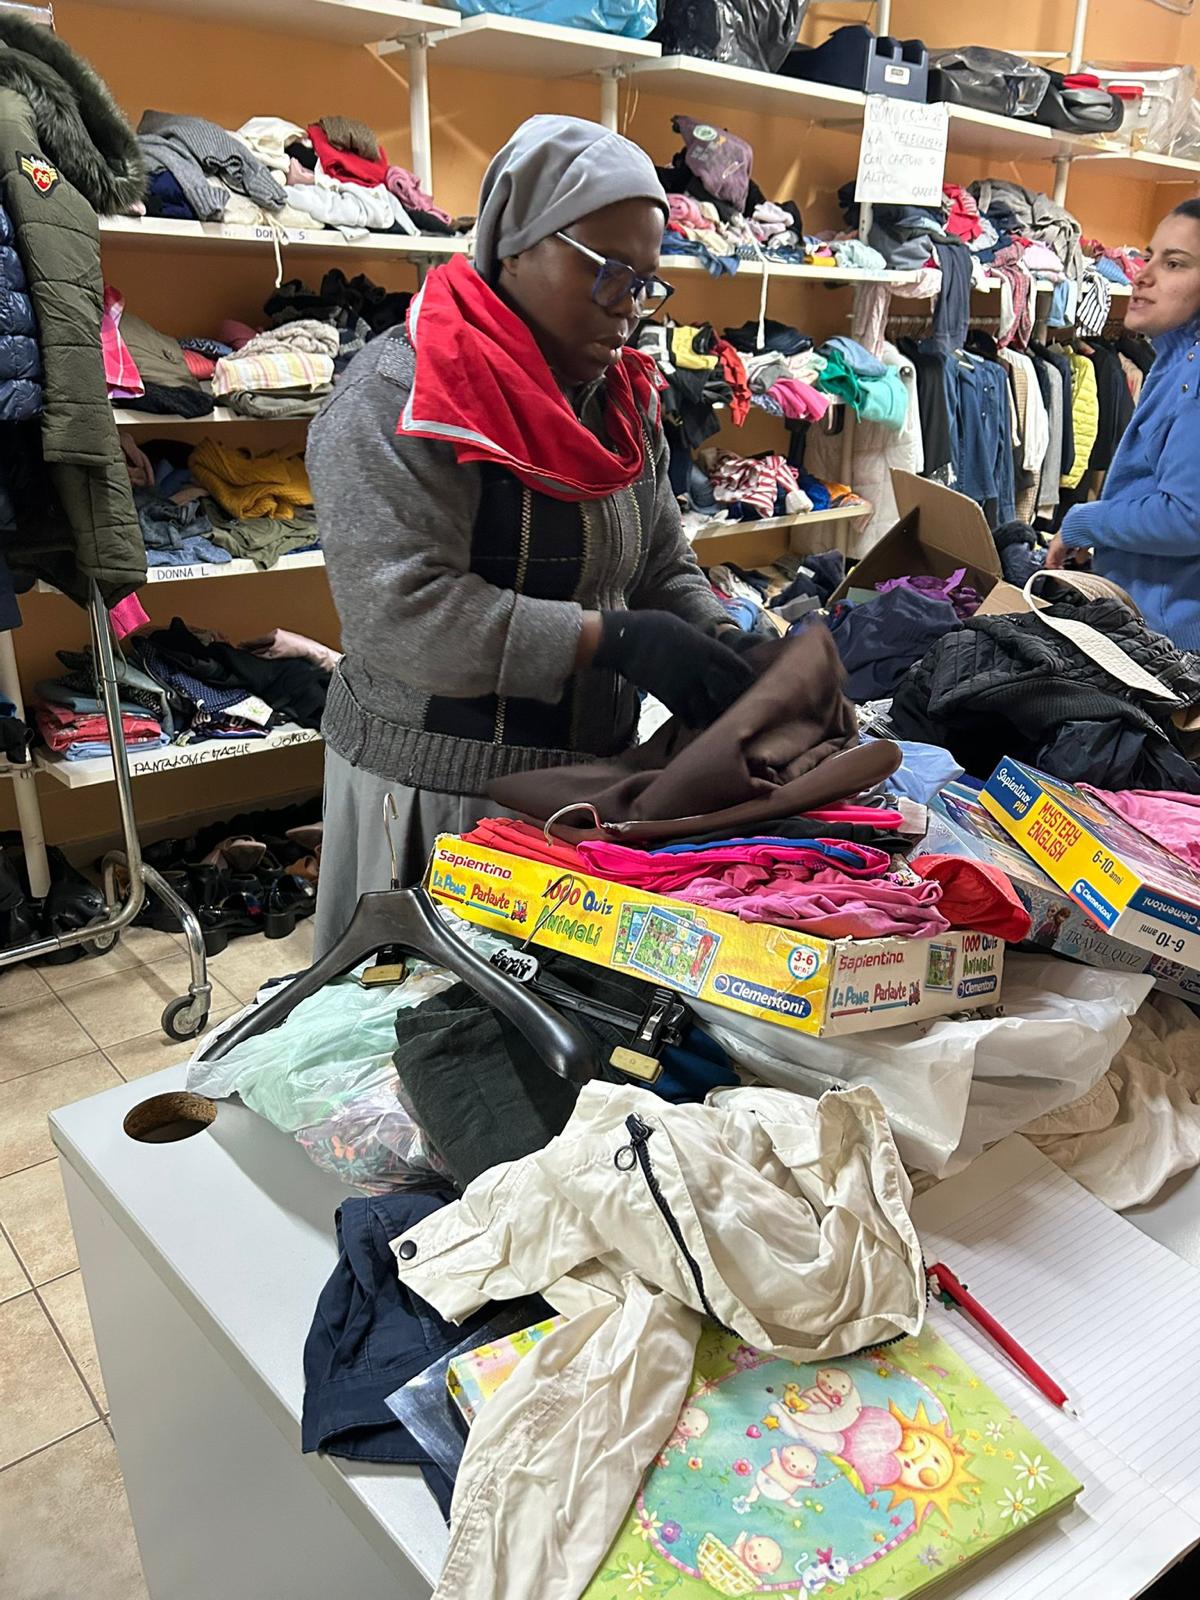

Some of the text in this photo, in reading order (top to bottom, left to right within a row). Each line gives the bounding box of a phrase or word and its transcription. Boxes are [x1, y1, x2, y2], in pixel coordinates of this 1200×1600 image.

[299, 231, 306, 240] S
[157, 566, 209, 580] DONNA L
[997, 768, 1032, 803] Sapientino
[1038, 801, 1083, 847] MYSTERY
[1027, 820, 1068, 862] ENGLISH
[433, 870, 442, 888] La
[438, 849, 512, 880] Sapientino
[1092, 850, 1124, 885] 6-10 anni
[546, 879, 614, 916] 1000 Quiz
[1082, 888, 1114, 921] Clementoni
[1142, 897, 1198, 925] Clementoni
[961, 934, 981, 954] 1000
[1066, 931, 1142, 967] TRAVEL QUIZ
[1140, 923, 1185, 952] 6-10 anni
[793, 951, 813, 966] 3-6
[838, 951, 904, 973] Sapientino
[731, 981, 805, 1016] Clementoni
[832, 987, 843, 1008] La
[964, 980, 994, 995] Clementoni
